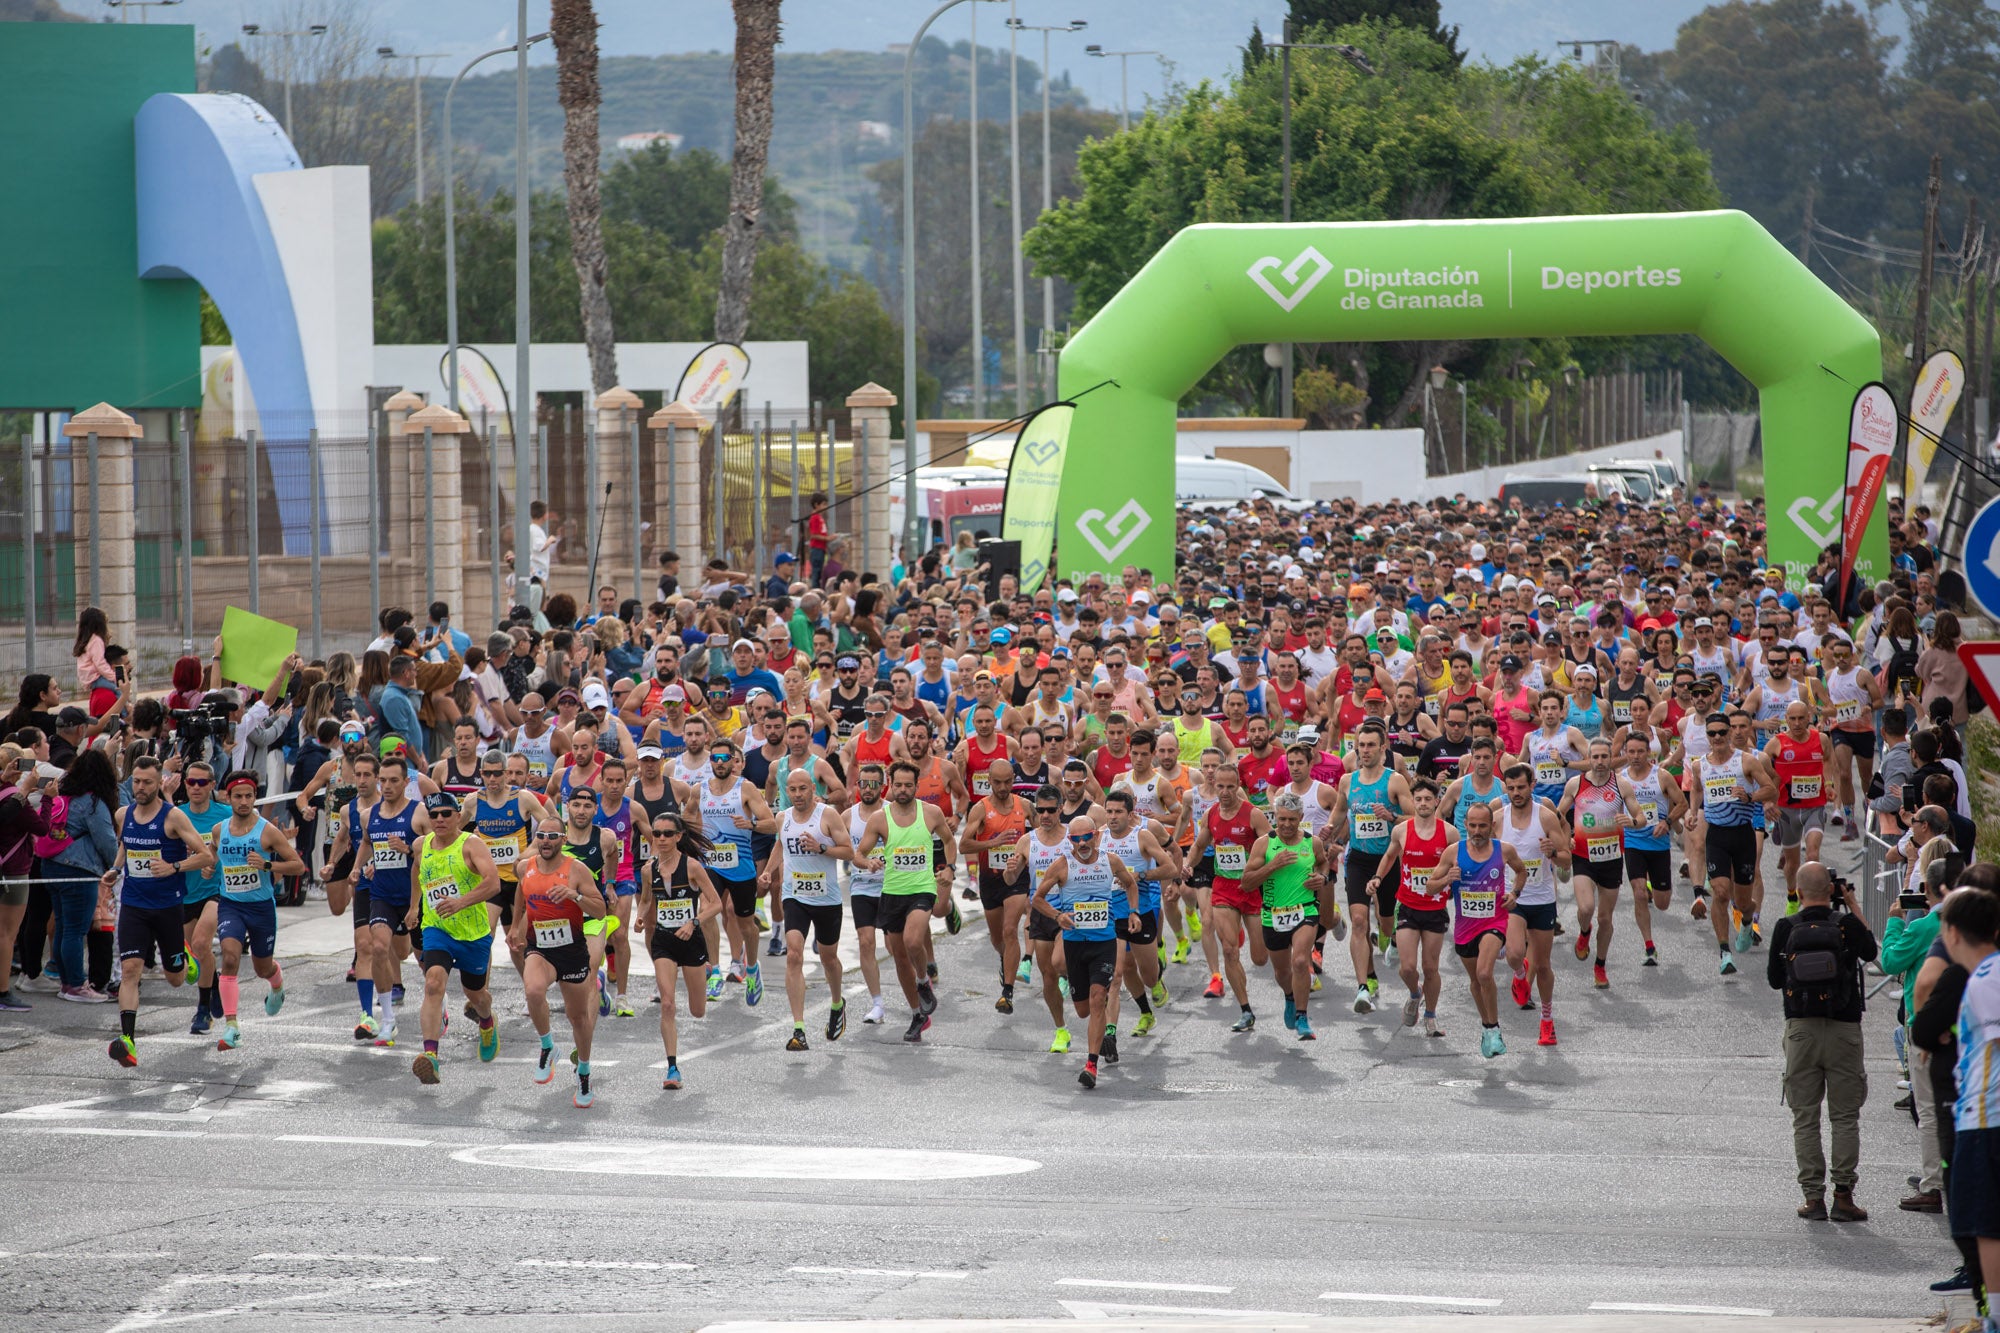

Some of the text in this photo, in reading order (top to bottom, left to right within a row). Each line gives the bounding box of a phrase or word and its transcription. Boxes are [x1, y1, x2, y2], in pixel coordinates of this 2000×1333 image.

[1344, 265, 1480, 291] Diputación
[1541, 264, 1682, 294] Deportes
[1340, 288, 1484, 310] de Granada
[1920, 367, 1949, 417] Cruzcampo
[1847, 464, 1880, 541] saborgranada.es
[1617, 708, 1631, 716] 83
[1839, 706, 1856, 717] 117
[1541, 770, 1561, 779] 375
[977, 781, 991, 790] 79
[1796, 784, 1817, 793] 555
[1710, 786, 1733, 797] 985
[703, 807, 736, 815] MARACENA
[478, 819, 516, 828] agustinos
[1359, 822, 1383, 832] 452
[123, 836, 161, 845] TROTASIERRA
[222, 844, 255, 857] nerja
[490, 846, 514, 858] 580
[1590, 843, 1618, 855] 4017
[375, 850, 403, 862] 3227
[894, 854, 926, 865] 3328
[1219, 854, 1241, 864] 233
[225, 873, 258, 886] 3220
[1074, 874, 1108, 882] MARACENA
[797, 880, 821, 891] 283
[427, 883, 458, 902] 1003
[1463, 900, 1494, 911] 3295
[659, 908, 692, 920] 3351
[1075, 910, 1108, 922] 3282
[1277, 913, 1300, 925] 274
[540, 928, 565, 941] 111
